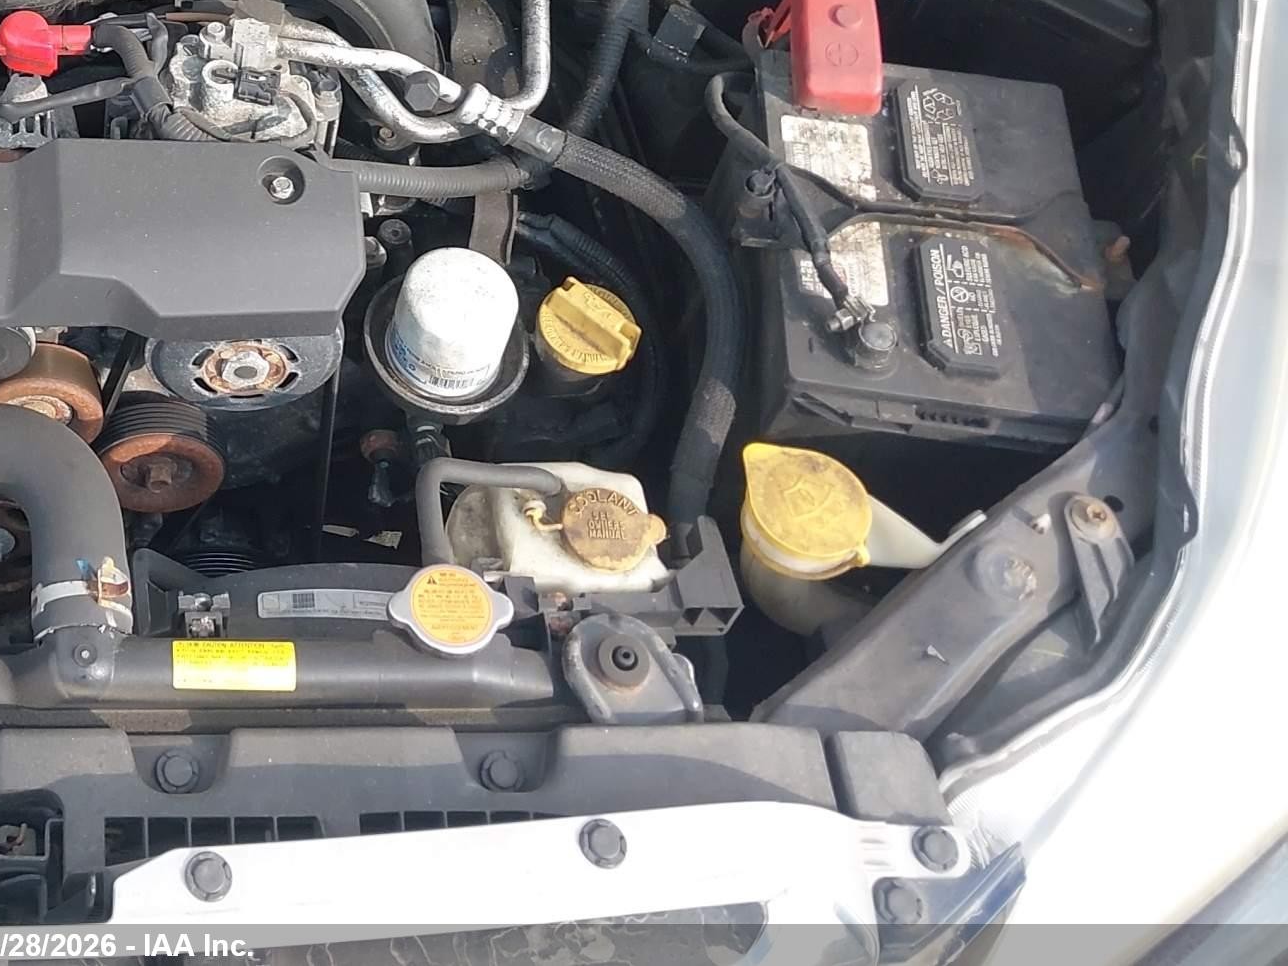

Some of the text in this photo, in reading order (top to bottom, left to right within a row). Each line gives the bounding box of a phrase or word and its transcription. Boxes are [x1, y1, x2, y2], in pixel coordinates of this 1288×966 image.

[930, 249, 944, 286] POISON
[936, 295, 952, 338] DANGER
[568, 489, 640, 515] COOLANT
[588, 530, 626, 539] MANUAL
